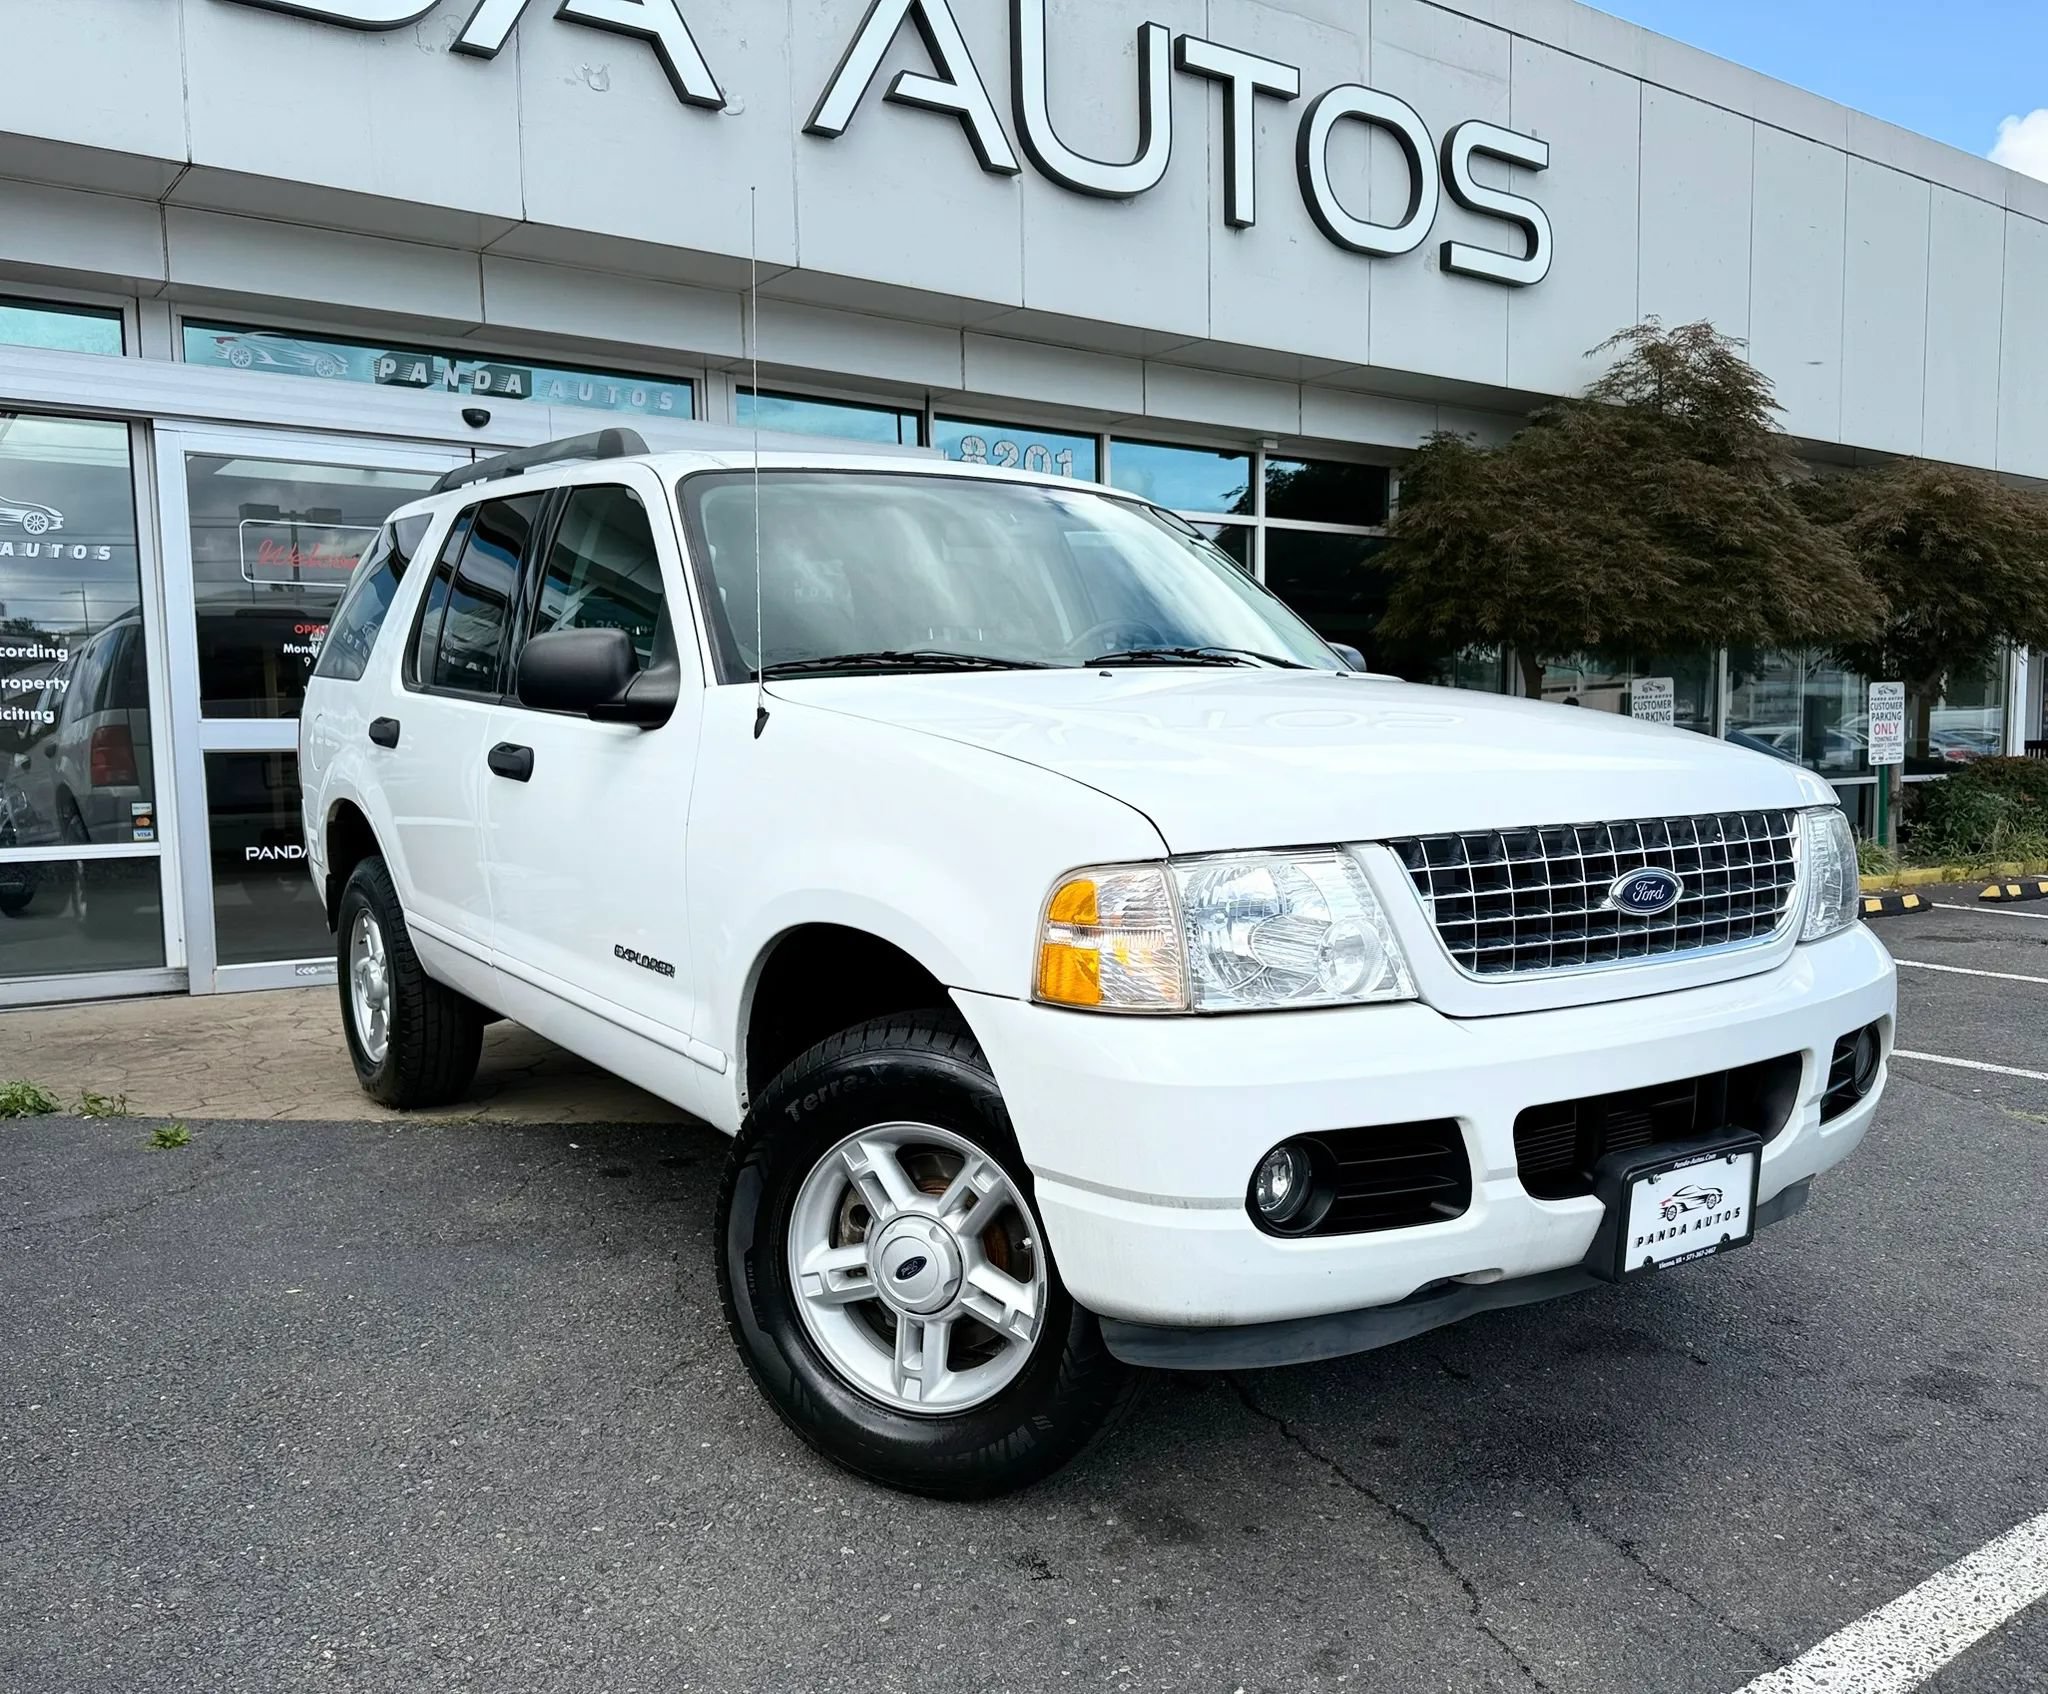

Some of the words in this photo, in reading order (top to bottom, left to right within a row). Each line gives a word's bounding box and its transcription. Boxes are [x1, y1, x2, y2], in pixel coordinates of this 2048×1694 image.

[801, 0, 1553, 288] AUTOS
[378, 358, 523, 394] PANDA
[548, 380, 673, 410] AUTOS
[960, 435, 1072, 478] 8201
[0, 541, 111, 561] AUTOS
[1633, 700, 1672, 711] CUSTOMER
[1870, 702, 1903, 711] CUSTOMER
[1872, 711, 1902, 721] PARKING
[1635, 711, 1671, 722] PARKING
[1874, 722, 1899, 736] ONLY
[1632, 880, 1665, 902] Ford
[614, 944, 676, 979] EXPLORER
[1634, 1224, 1687, 1248] PANDA
[1693, 1207, 1741, 1232] AUTOS
